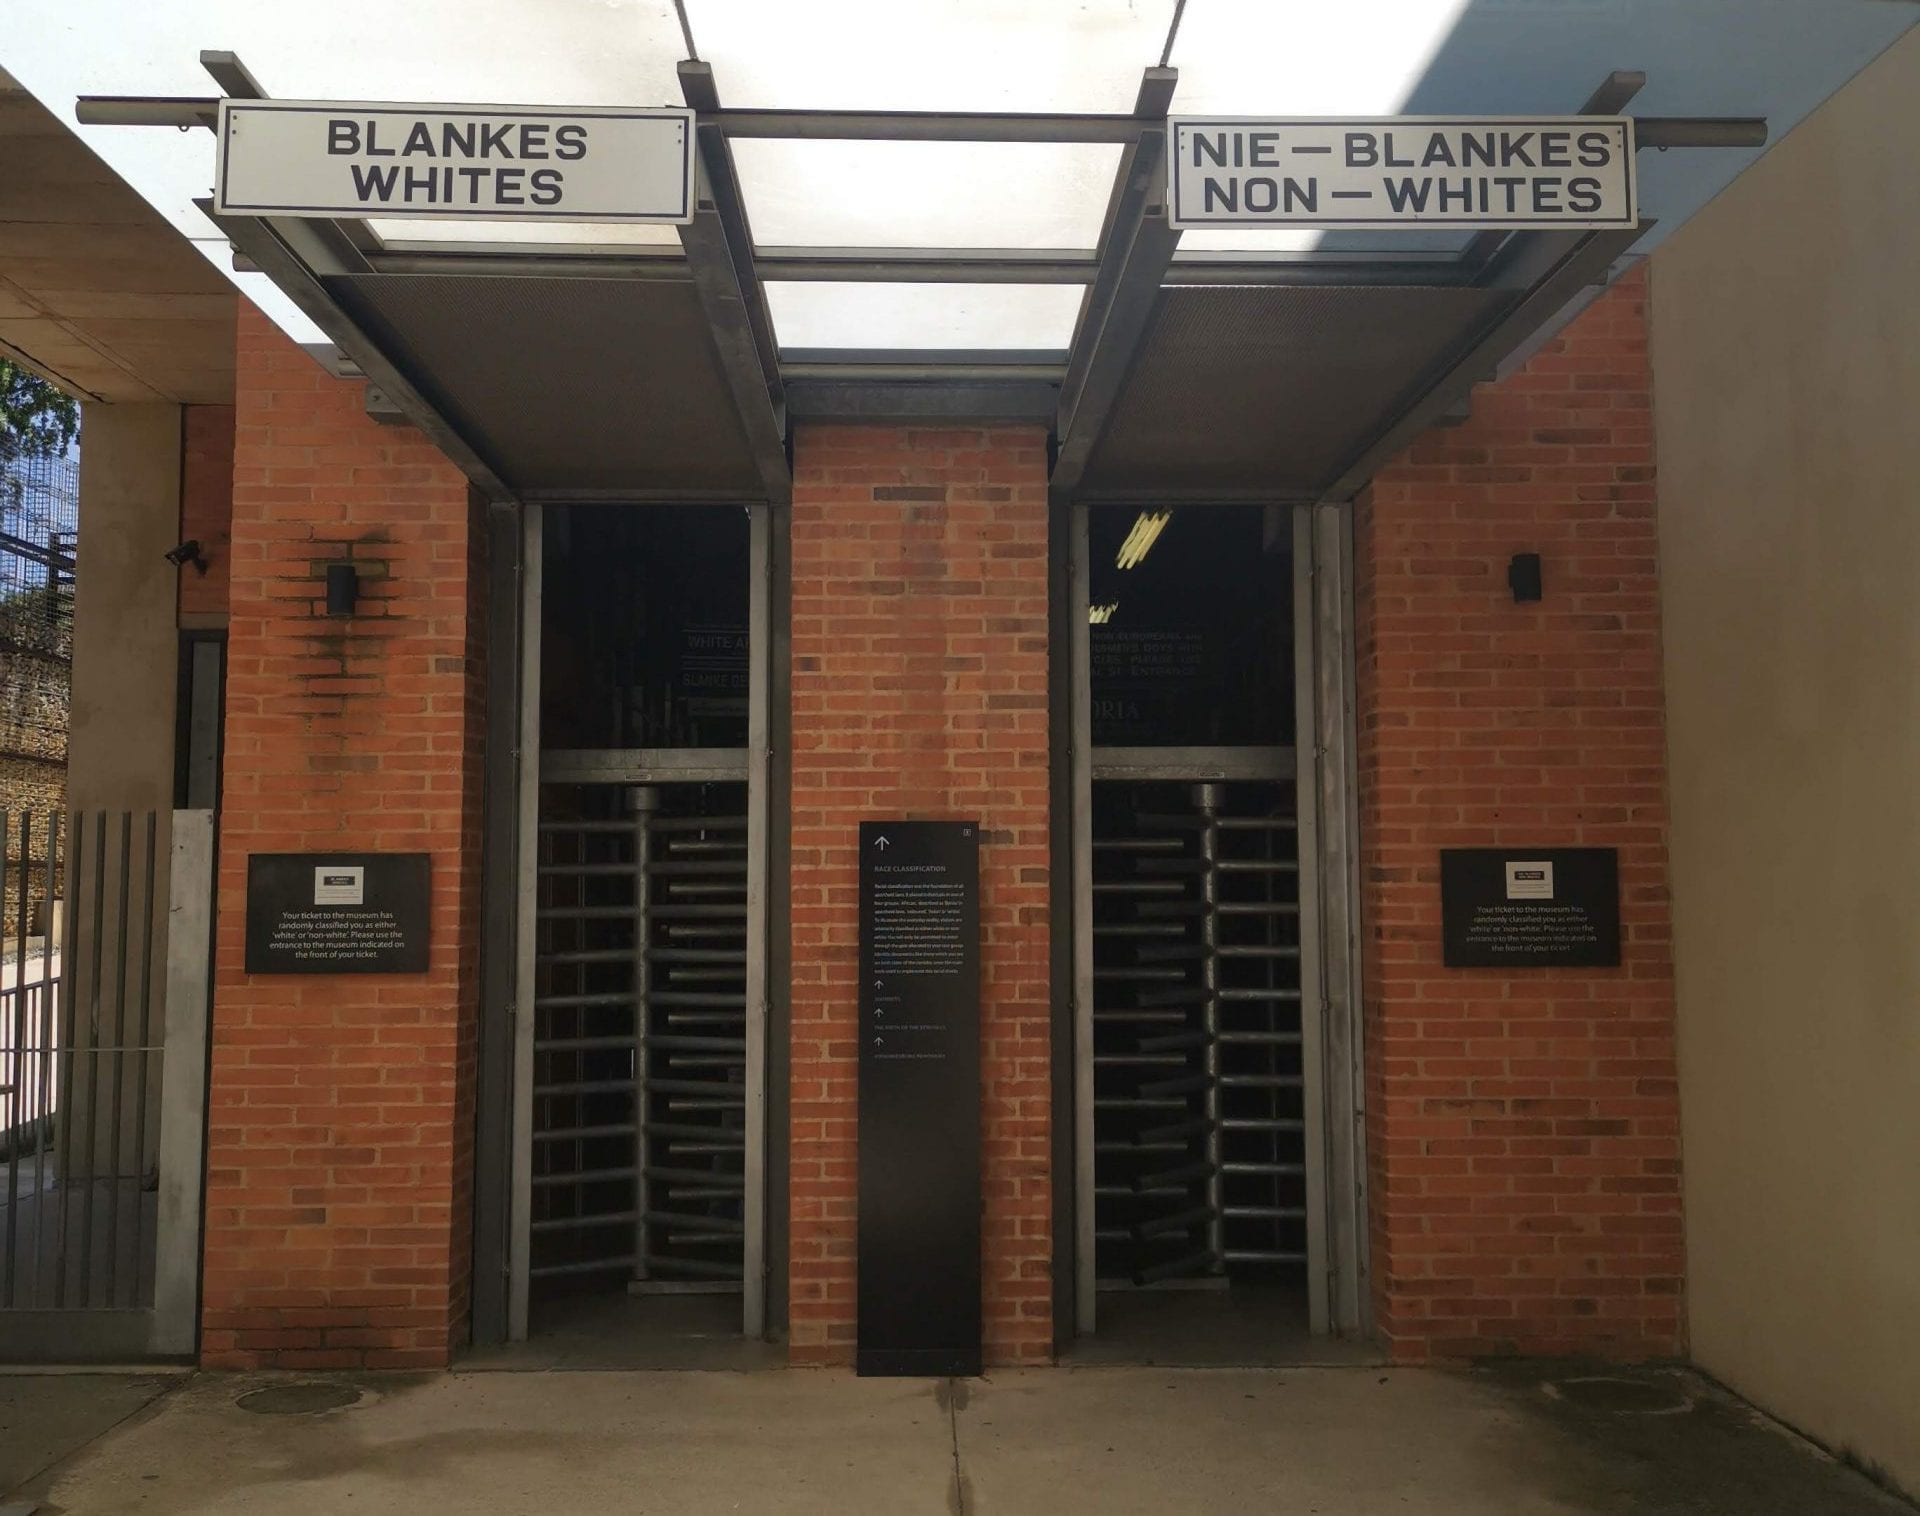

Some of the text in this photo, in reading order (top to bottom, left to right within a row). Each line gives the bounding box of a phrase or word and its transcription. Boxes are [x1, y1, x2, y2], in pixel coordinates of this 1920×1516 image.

[328, 120, 587, 160] BLANKES
[350, 164, 563, 205] WHITES
[688, 635, 732, 649] WHITE
[893, 865, 947, 873] CLASSIFICATION
[282, 912, 300, 920] Your
[301, 911, 322, 919] ticket
[323, 911, 331, 919] to
[332, 911, 345, 919] the
[380, 910, 393, 919] has
[278, 922, 314, 931] randomly
[315, 921, 349, 929] classified
[350, 922, 363, 930] you
[375, 920, 397, 929] either
[1543, 917, 1556, 925] you
[1581, 924, 1595, 932] the
[351, 931, 374, 939] Please
[390, 930, 403, 938] the
[312, 941, 325, 949] the
[360, 940, 393, 948] indicated
[338, 952, 356, 961] your
